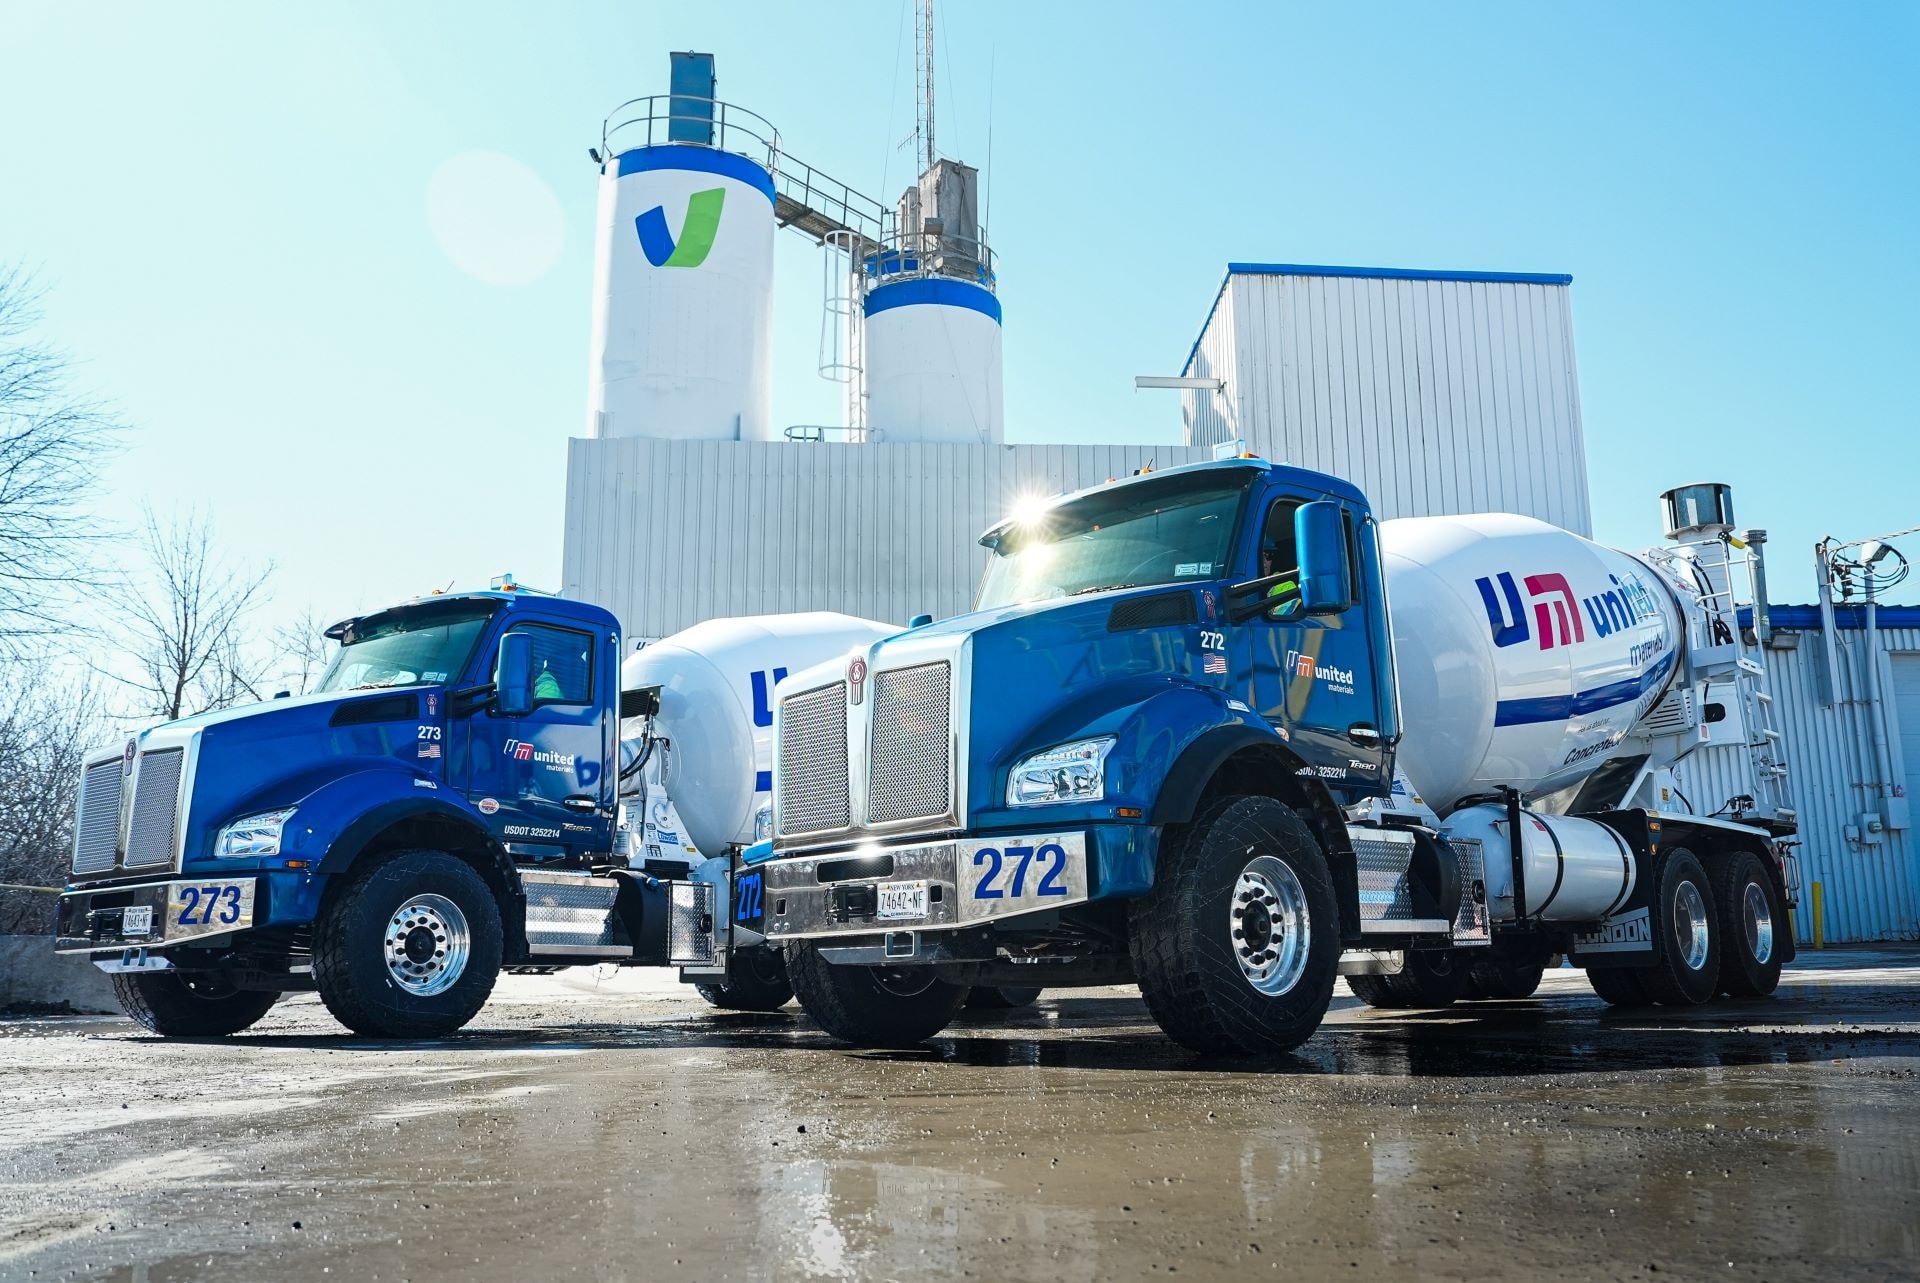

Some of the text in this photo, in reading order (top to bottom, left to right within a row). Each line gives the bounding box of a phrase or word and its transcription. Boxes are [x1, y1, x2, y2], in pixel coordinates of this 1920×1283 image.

[1200, 631, 1225, 651] 272
[1315, 665, 1353, 684] united
[1328, 683, 1354, 695] materials
[417, 725, 441, 740] 273
[533, 751, 574, 766] united
[546, 764, 574, 774] materials
[1318, 766, 1347, 779] 3252214
[504, 825, 560, 838] USDOT 3252214
[973, 843, 1068, 900] 272
[737, 872, 762, 921] 272
[178, 885, 241, 925] 273
